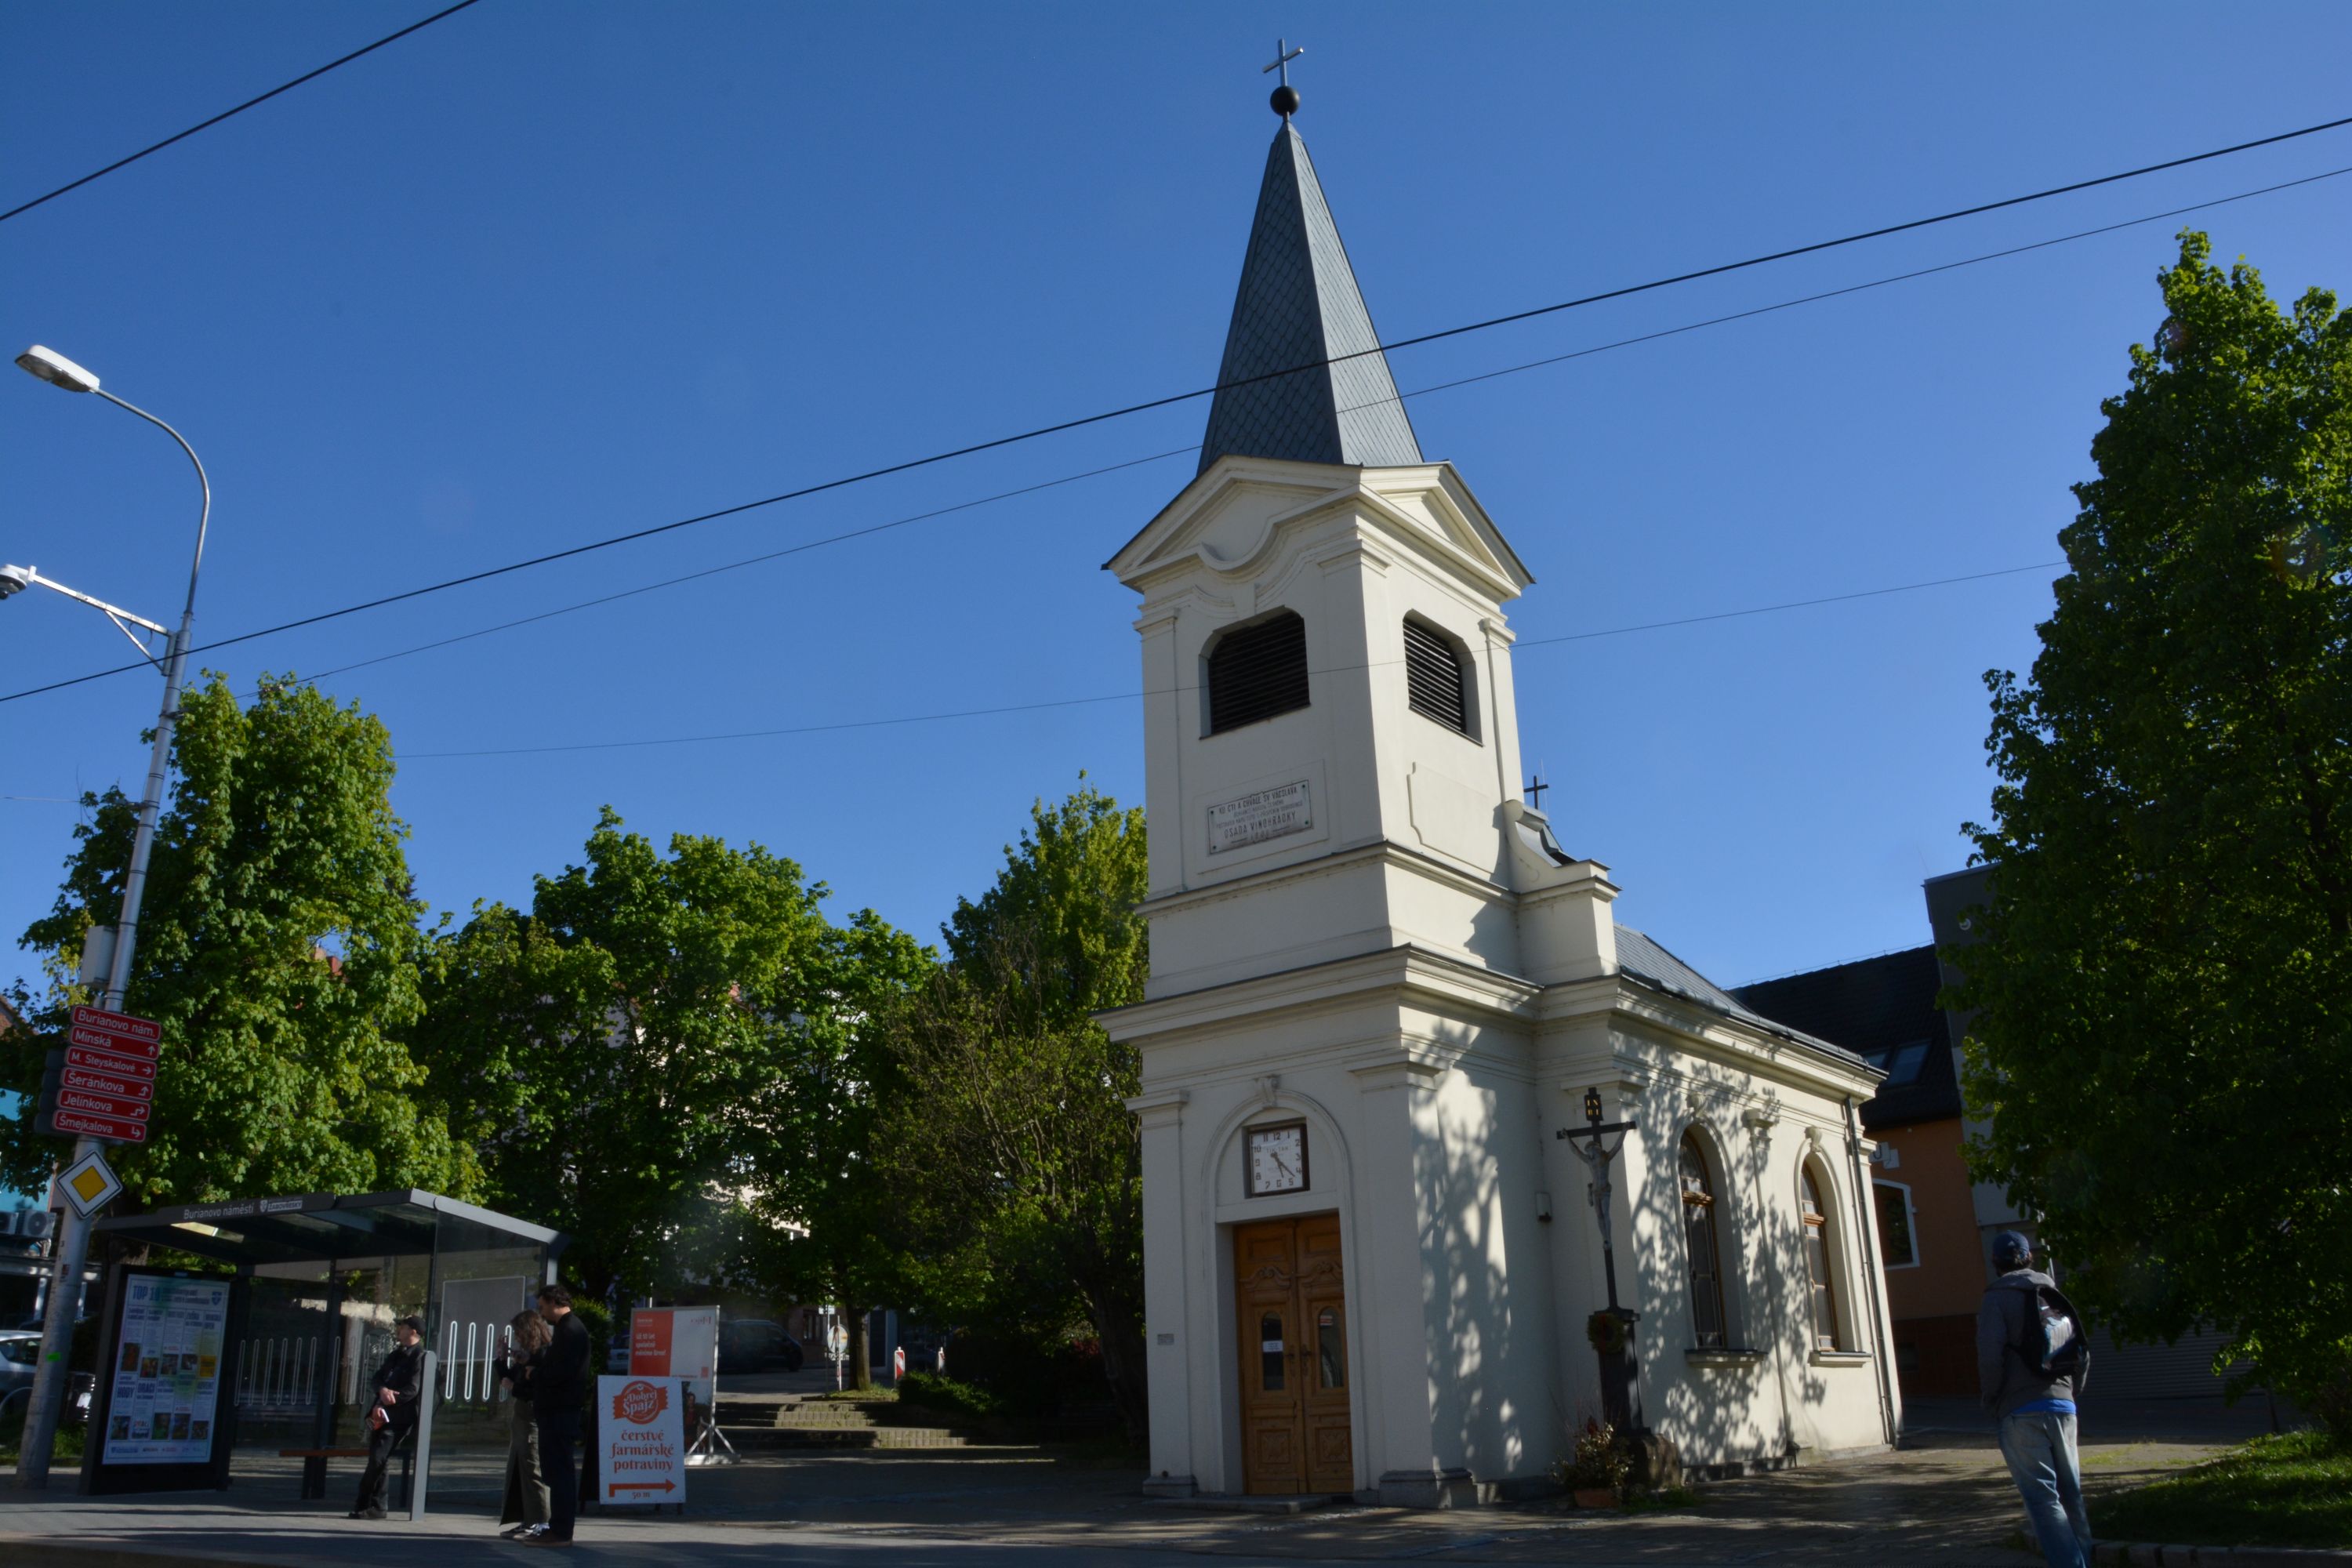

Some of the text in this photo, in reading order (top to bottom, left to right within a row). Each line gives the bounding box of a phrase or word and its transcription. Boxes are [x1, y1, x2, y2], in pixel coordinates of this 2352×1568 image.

[1224, 824, 1247, 839] OSADA
[78, 1010, 155, 1038] Burianovo nám.
[74, 1031, 112, 1047] Minská
[71, 1052, 136, 1073] M. Steyskalové
[67, 1071, 125, 1093] Šeránkova
[64, 1094, 113, 1112] Jelínkova
[60, 1114, 113, 1134] Šmejkalova
[1273, 1131, 1280, 1141] 12
[1294, 1138, 1301, 1147] 2
[1254, 1145, 1261, 1153] 10
[1265, 1178, 1294, 1190] 7 6 5
[183, 1209, 222, 1220] Burianovo
[223, 1203, 255, 1216] náměstí
[133, 1286, 147, 1301] TOP
[149, 1287, 161, 1301] 10
[623, 1392, 657, 1403] Dobrej
[622, 1399, 655, 1416] Špajz
[621, 1430, 664, 1441] čerstvé
[609, 1443, 674, 1459] farmářské
[614, 1458, 673, 1474] potraviny
